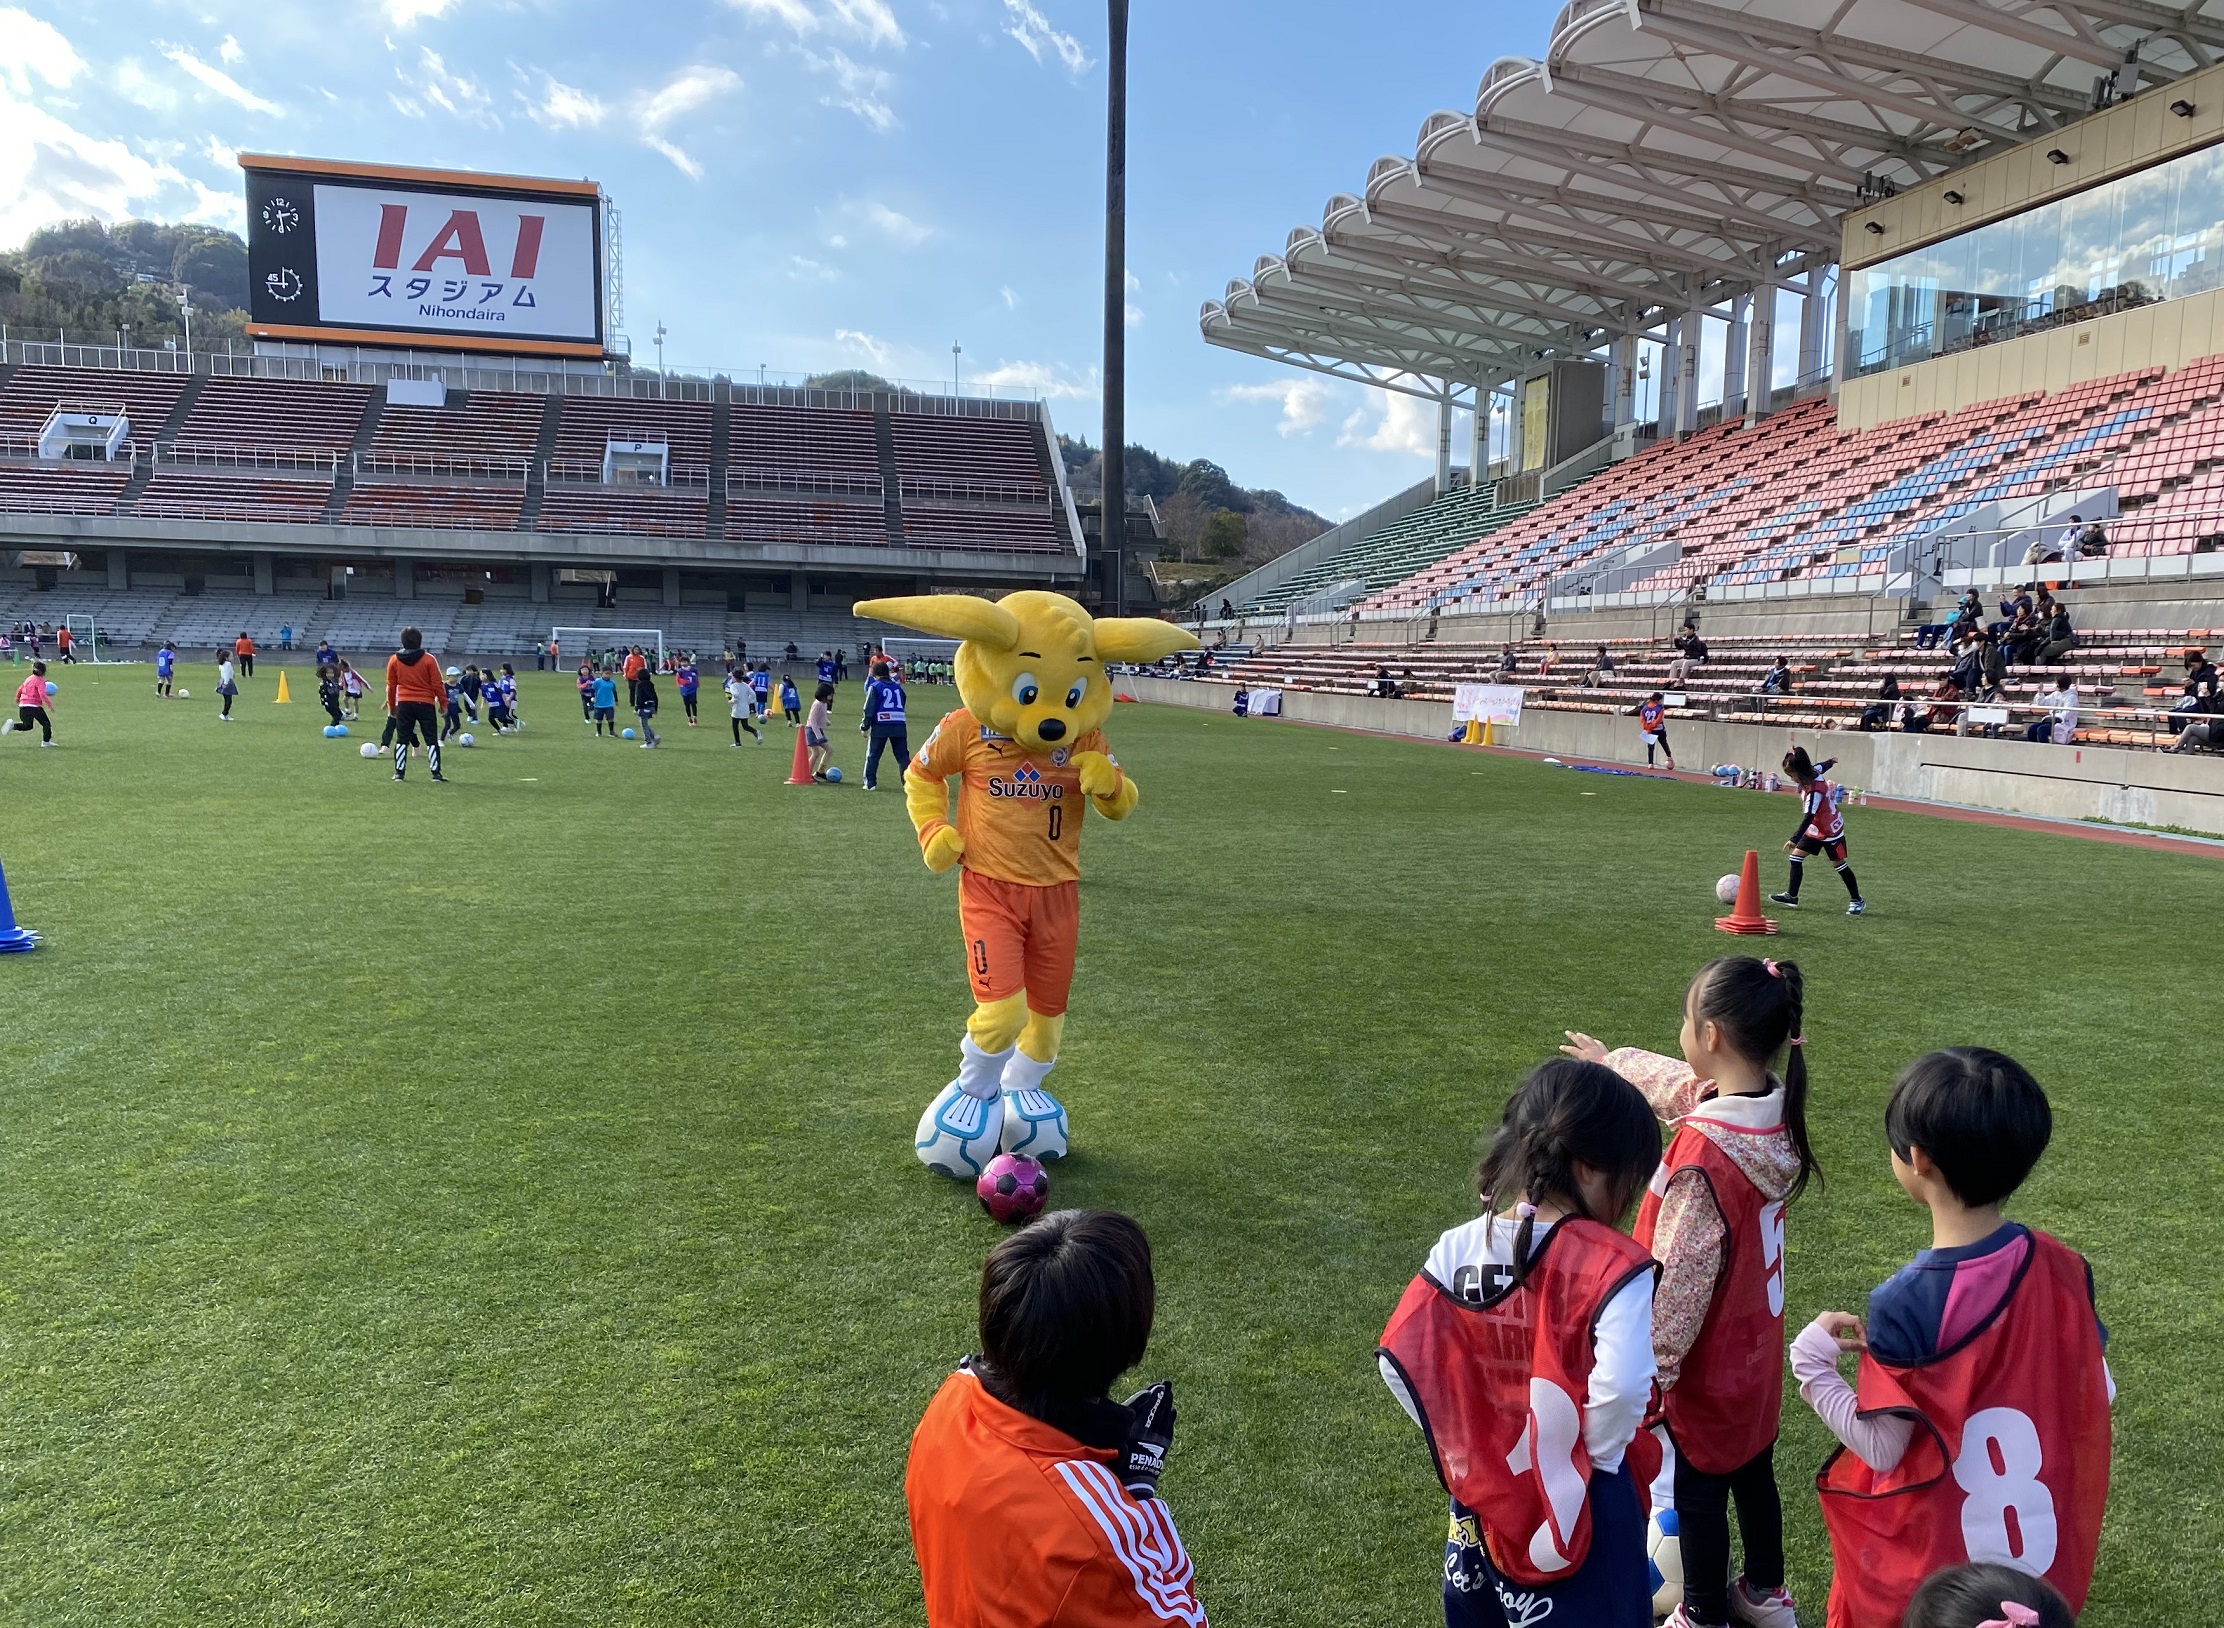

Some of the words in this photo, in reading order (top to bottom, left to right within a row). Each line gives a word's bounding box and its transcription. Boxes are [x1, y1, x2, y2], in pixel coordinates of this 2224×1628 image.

[275, 197, 285, 207] 12
[262, 210, 269, 219] 9
[292, 213, 299, 221] 3
[372, 203, 545, 279] IAI
[267, 273, 279, 281] 45
[368, 275, 536, 308] スタジアム
[419, 304, 505, 321] Nihondaira
[88, 416, 98, 425] Q
[634, 443, 642, 451] P
[757, 676, 766, 687] 11
[788, 688, 796, 698] 2
[882, 687, 904, 709] 21
[988, 777, 1064, 801] Suzuyo
[1048, 805, 1063, 841] 0
[973, 939, 989, 976] 0
[1952, 1407, 2058, 1577] 8
